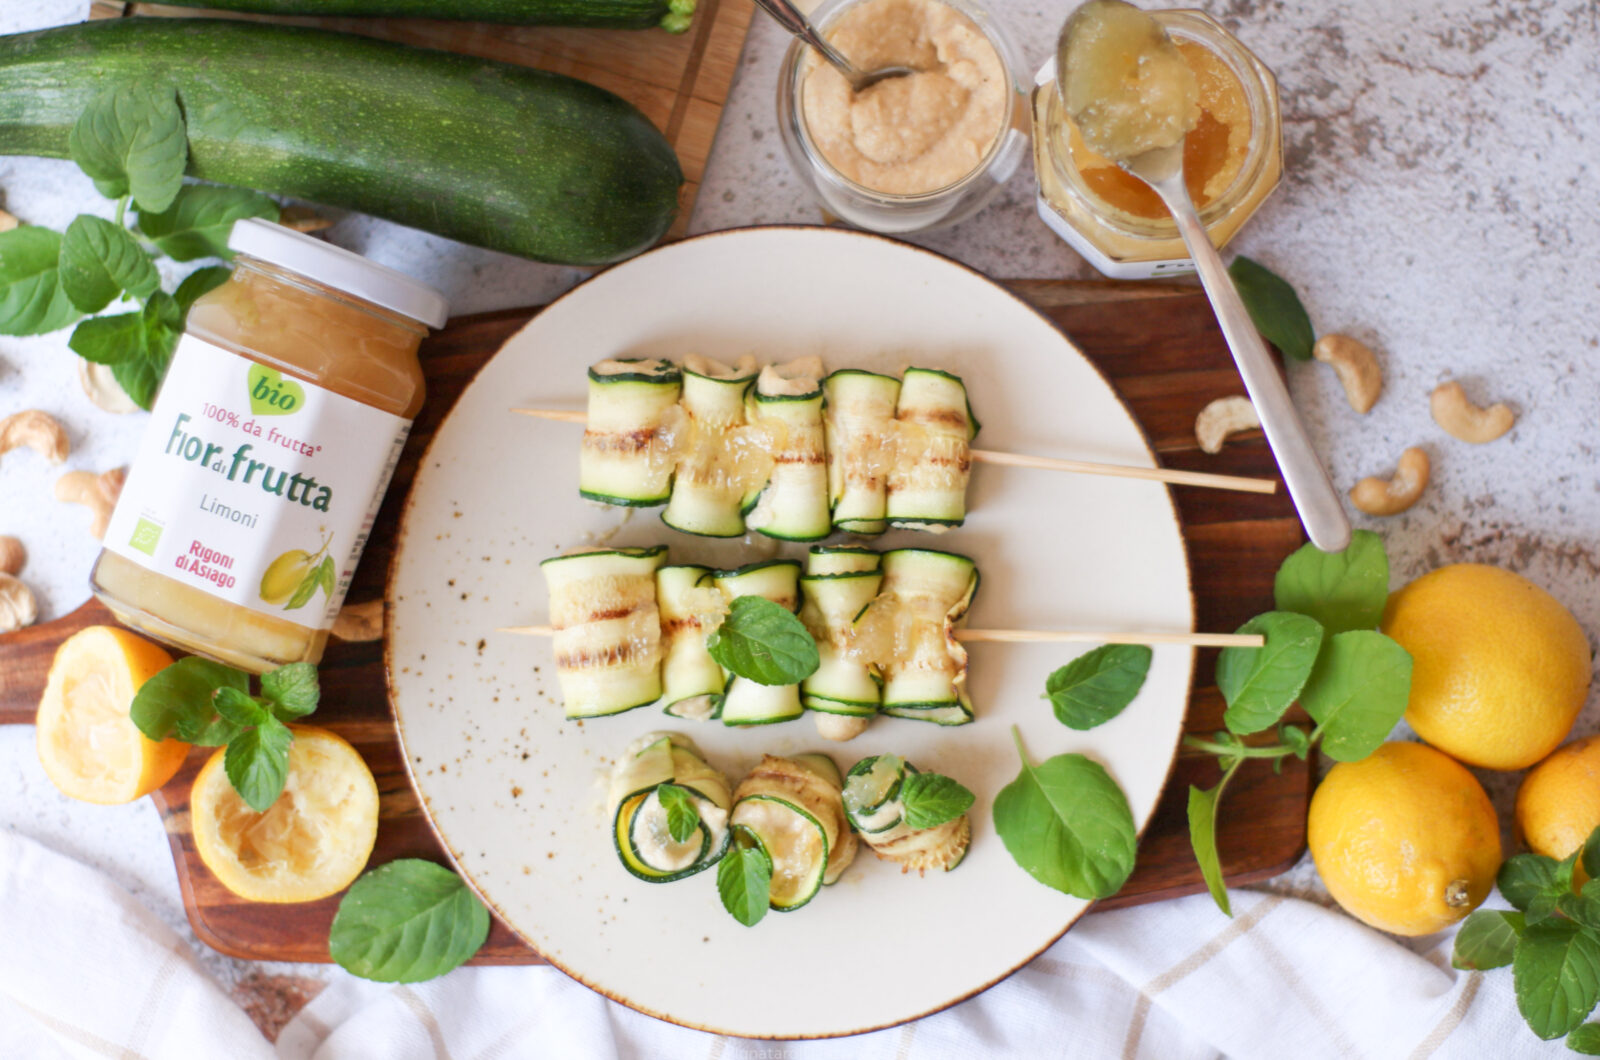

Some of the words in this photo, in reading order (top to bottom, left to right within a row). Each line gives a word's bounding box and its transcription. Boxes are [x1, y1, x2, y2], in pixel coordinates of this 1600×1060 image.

[252, 375, 297, 411] bio
[201, 402, 239, 429] 100%
[242, 418, 262, 437] da
[165, 412, 224, 468] Fior
[212, 459, 228, 474] di
[226, 443, 333, 513] frutta
[200, 494, 259, 529] Limoni
[189, 540, 235, 569] Rigoni
